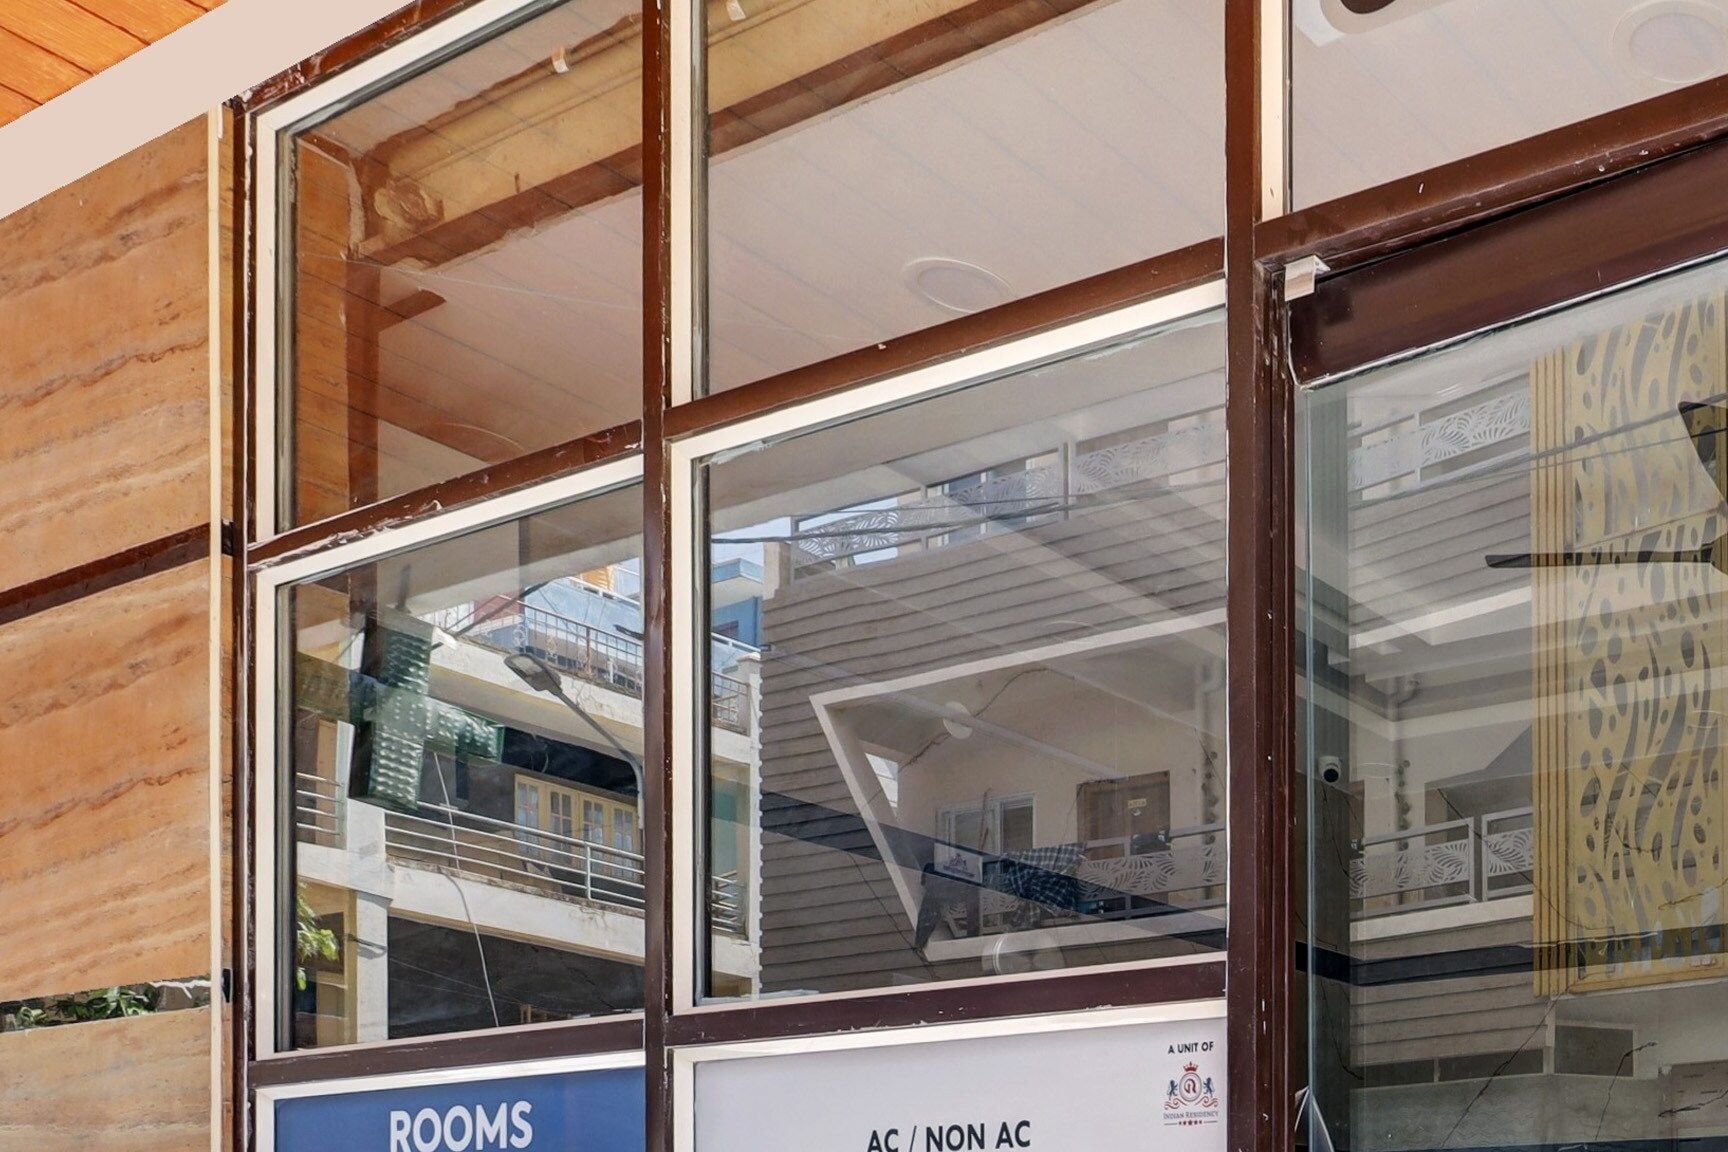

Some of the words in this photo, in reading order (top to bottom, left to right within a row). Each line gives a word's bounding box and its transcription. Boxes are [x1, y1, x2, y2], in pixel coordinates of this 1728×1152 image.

[1168, 1045, 1175, 1054] A
[1177, 1042, 1199, 1054] UNIT
[1201, 1041, 1214, 1051] OF
[995, 1119, 1031, 1149] AC
